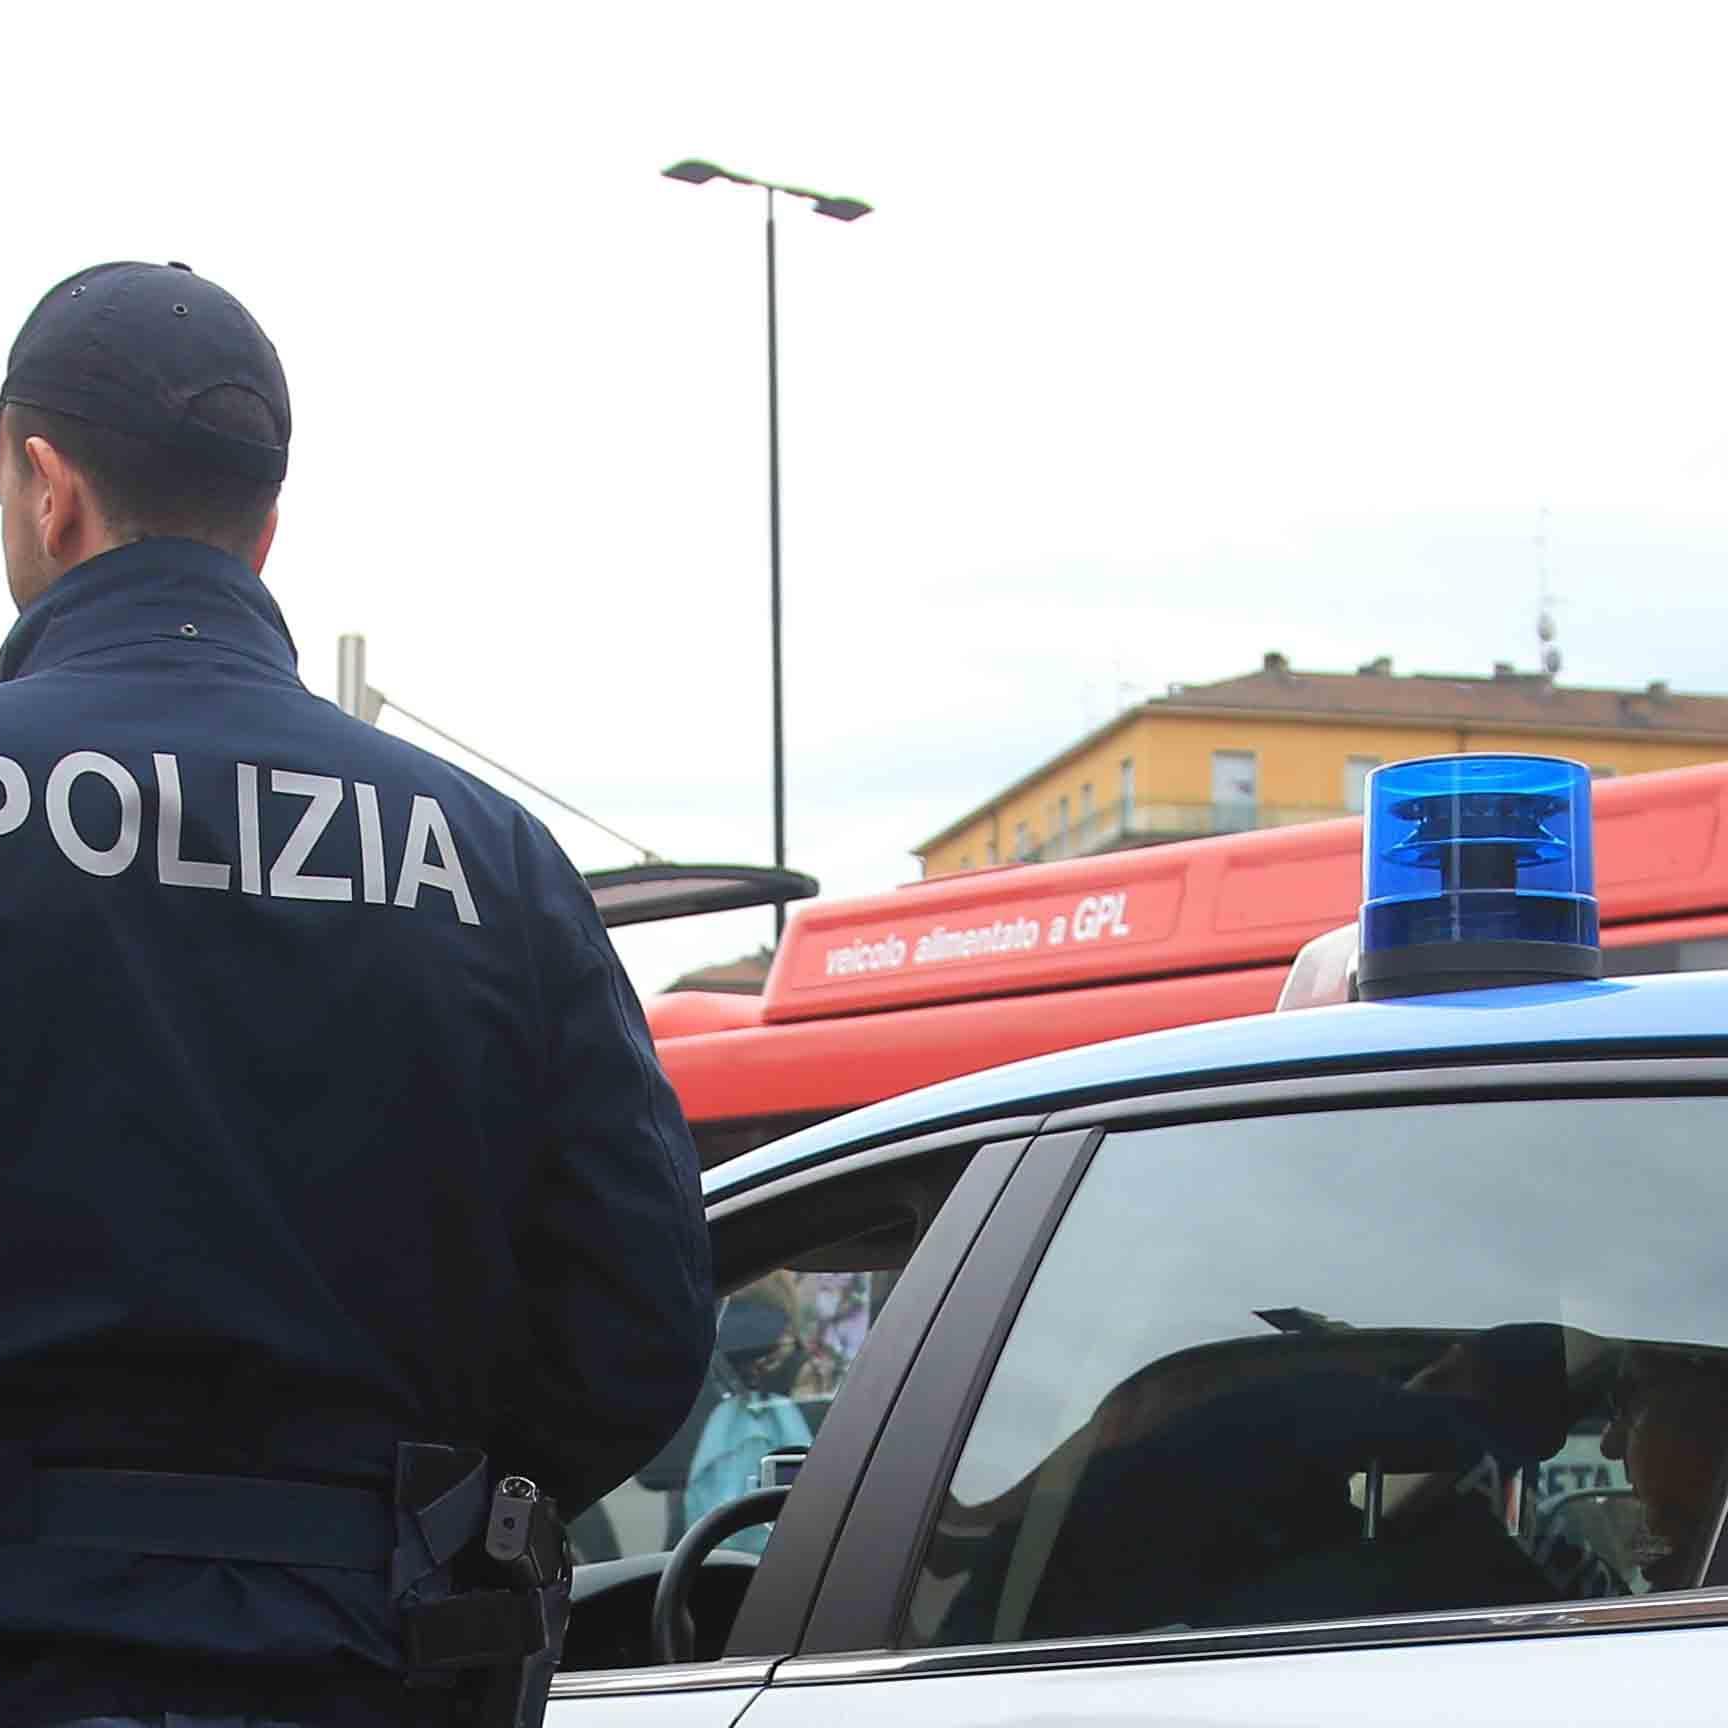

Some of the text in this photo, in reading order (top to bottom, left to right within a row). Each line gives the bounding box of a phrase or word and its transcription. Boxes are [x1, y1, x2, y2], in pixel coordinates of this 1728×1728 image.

[826, 892, 1130, 975] veicolo alimentato a GPL
